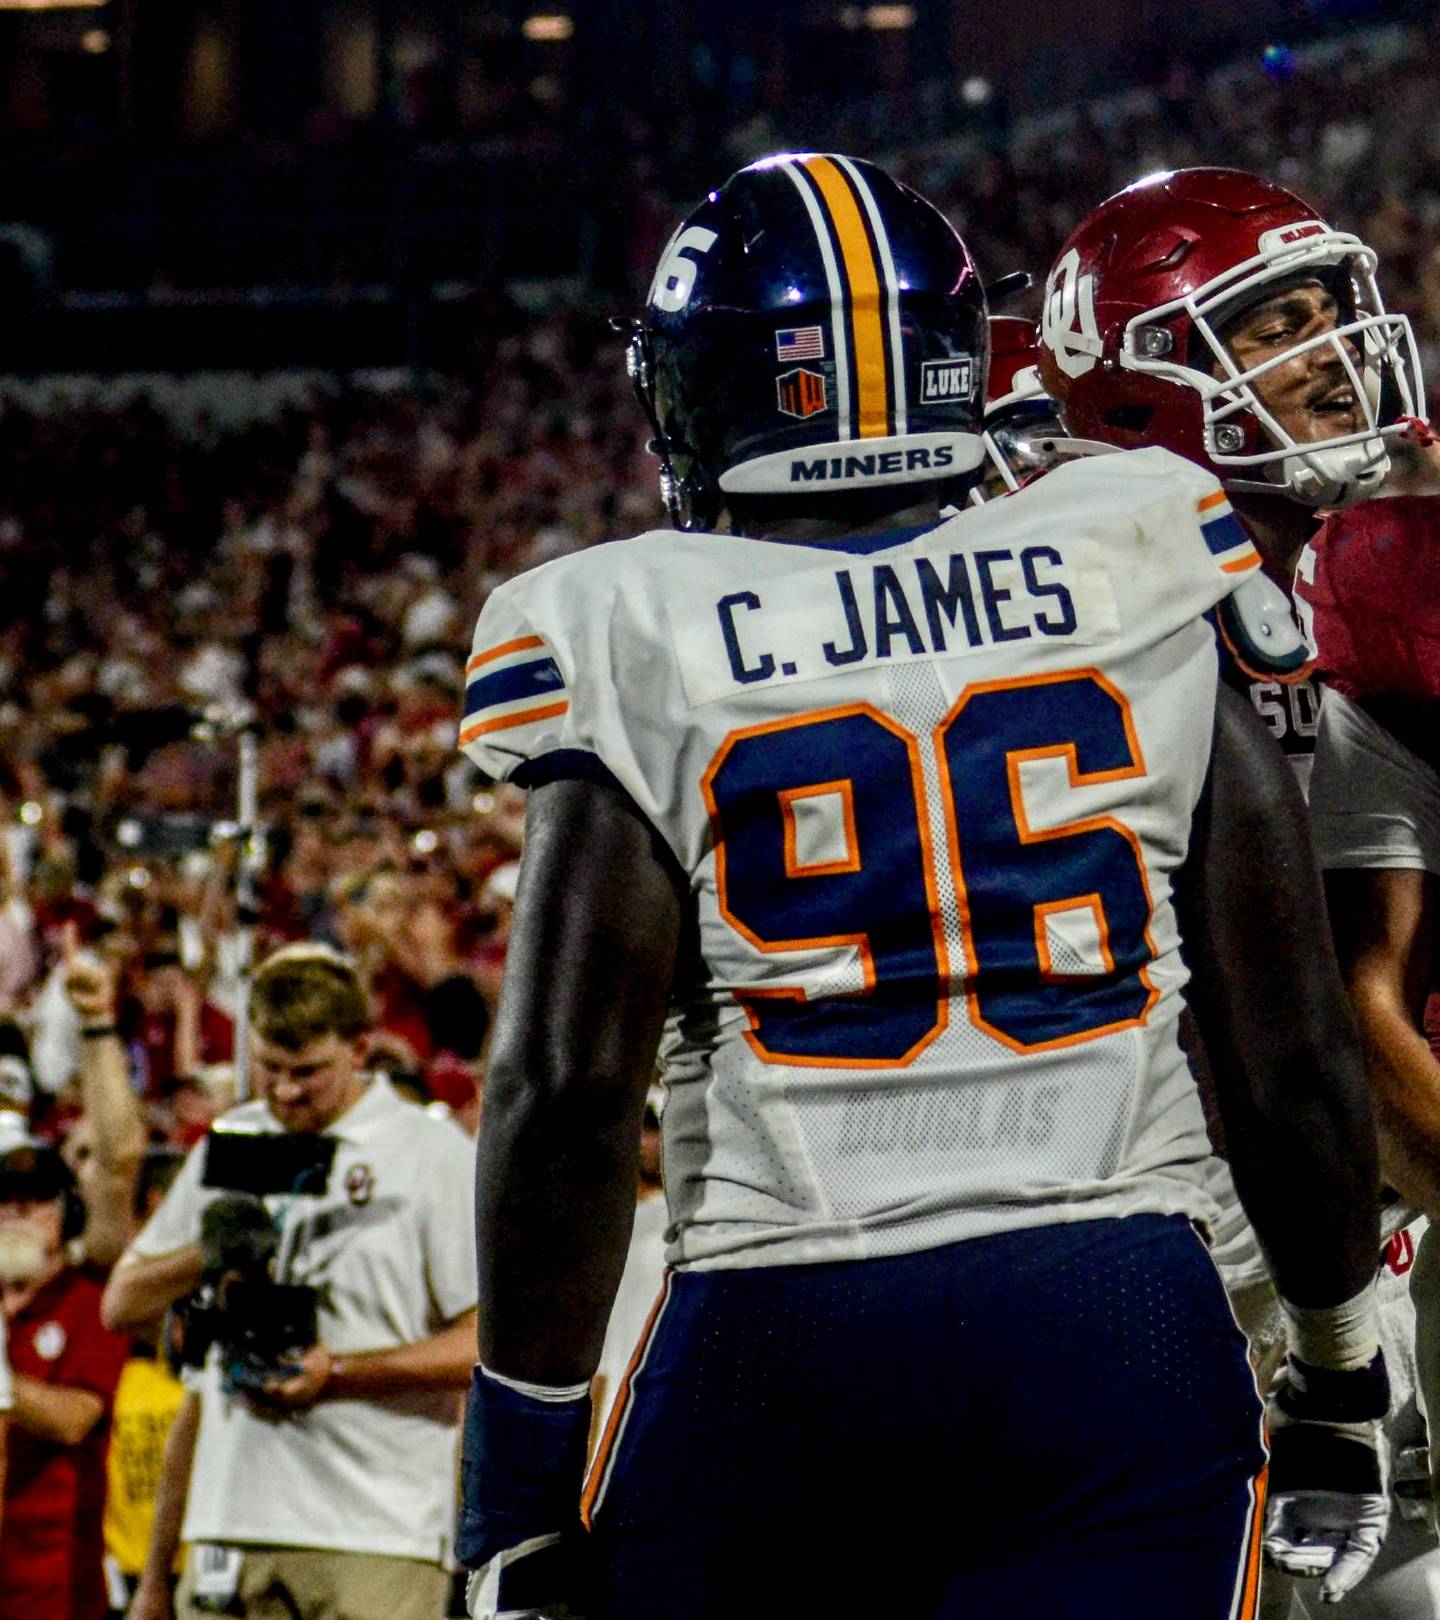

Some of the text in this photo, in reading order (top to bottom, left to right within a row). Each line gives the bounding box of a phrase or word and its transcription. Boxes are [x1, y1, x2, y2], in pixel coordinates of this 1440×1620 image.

[925, 365, 970, 397] LUKE
[789, 445, 954, 483] MINERS
[716, 545, 1078, 685] C. JAMES
[700, 666, 1160, 1069] 96
